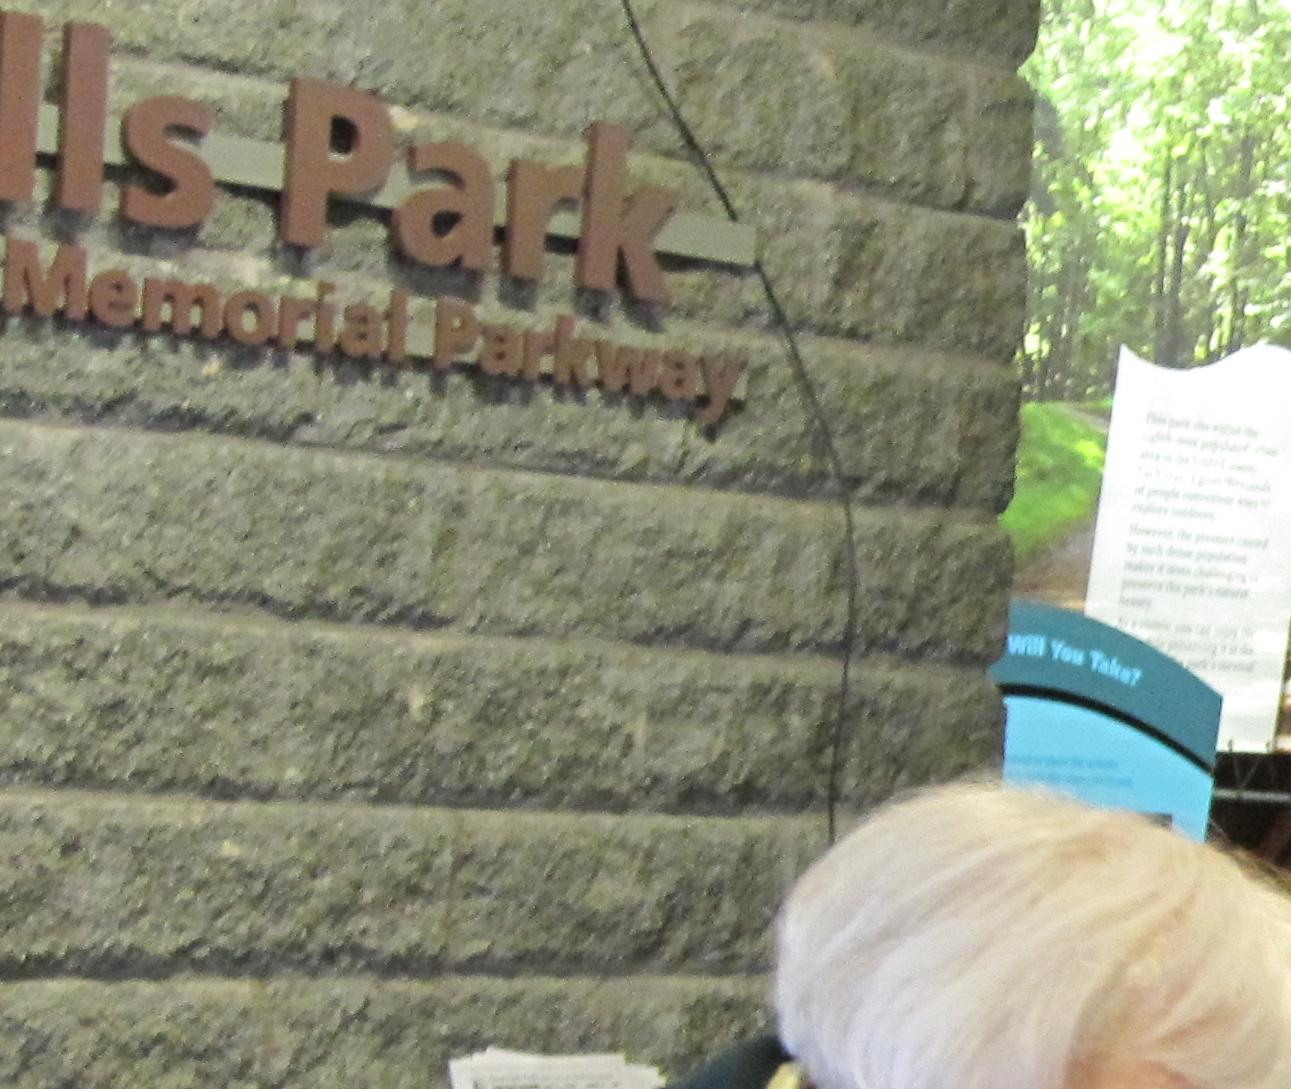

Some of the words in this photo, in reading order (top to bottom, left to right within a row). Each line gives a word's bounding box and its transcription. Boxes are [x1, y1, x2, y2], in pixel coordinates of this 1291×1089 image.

[280, 75, 679, 304] Park
[3, 238, 407, 362] Memorial
[434, 297, 750, 425] Parkway
[1050, 638, 1084, 667] You
[1088, 649, 1143, 688] Take?
